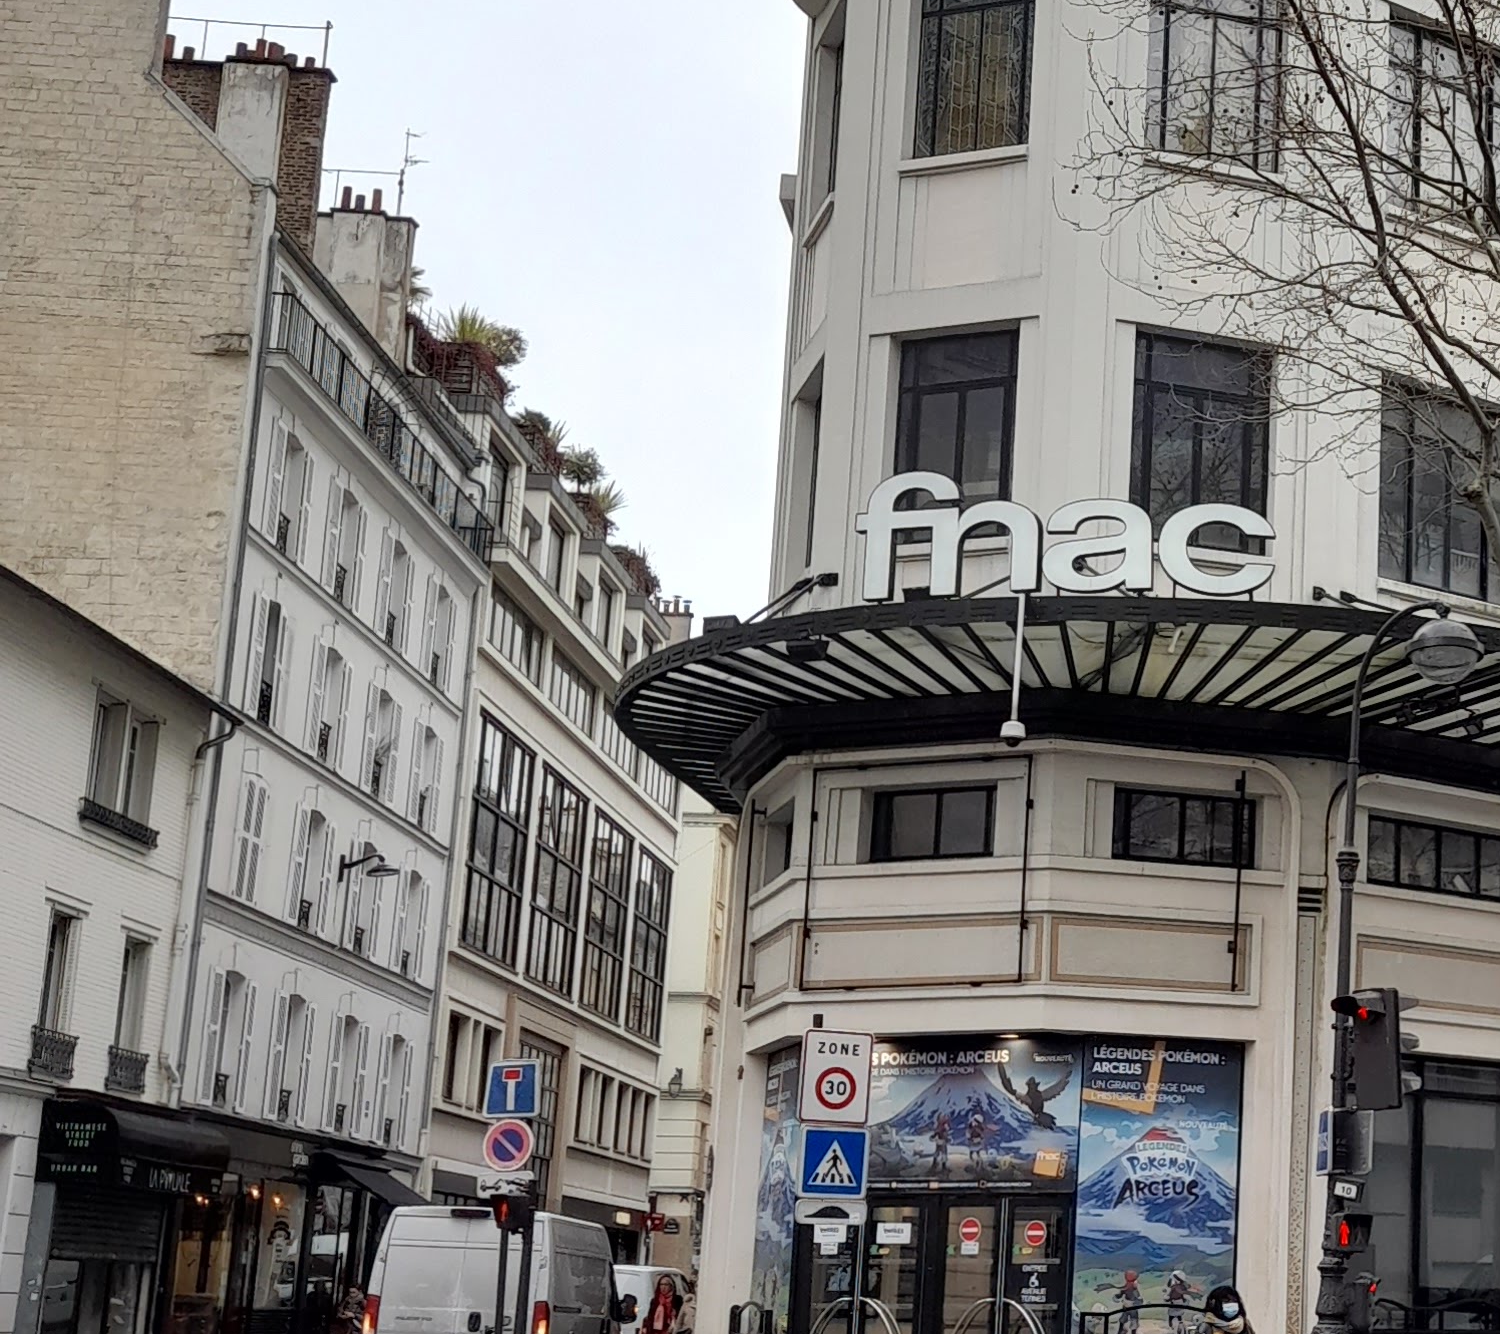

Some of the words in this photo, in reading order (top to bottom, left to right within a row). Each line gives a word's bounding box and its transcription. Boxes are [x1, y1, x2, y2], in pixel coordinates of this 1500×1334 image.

[855, 470, 1276, 602] fnac
[817, 1041, 861, 1057] ZONE
[1093, 1044, 1157, 1061] LÉGENDES
[1158, 1049, 1220, 1065] POKÉMON
[881, 1049, 947, 1066] POKÉMON
[957, 1049, 1010, 1065] ARCEUS
[1092, 1061, 1143, 1075] ARCEUS
[824, 1080, 847, 1097] 30
[1091, 1079, 1106, 1089] UN
[1107, 1080, 1141, 1090] GRAND
[1142, 1081, 1179, 1093] VOYAGE
[1180, 1083, 1206, 1094] DANS
[50, 1163, 77, 1173] URBAN
[81, 1164, 98, 1173] BAR
[1113, 1177, 1202, 1212] ARCEUS
[1341, 1185, 1353, 1196] 10
[1029, 1272, 1040, 1287] 6
